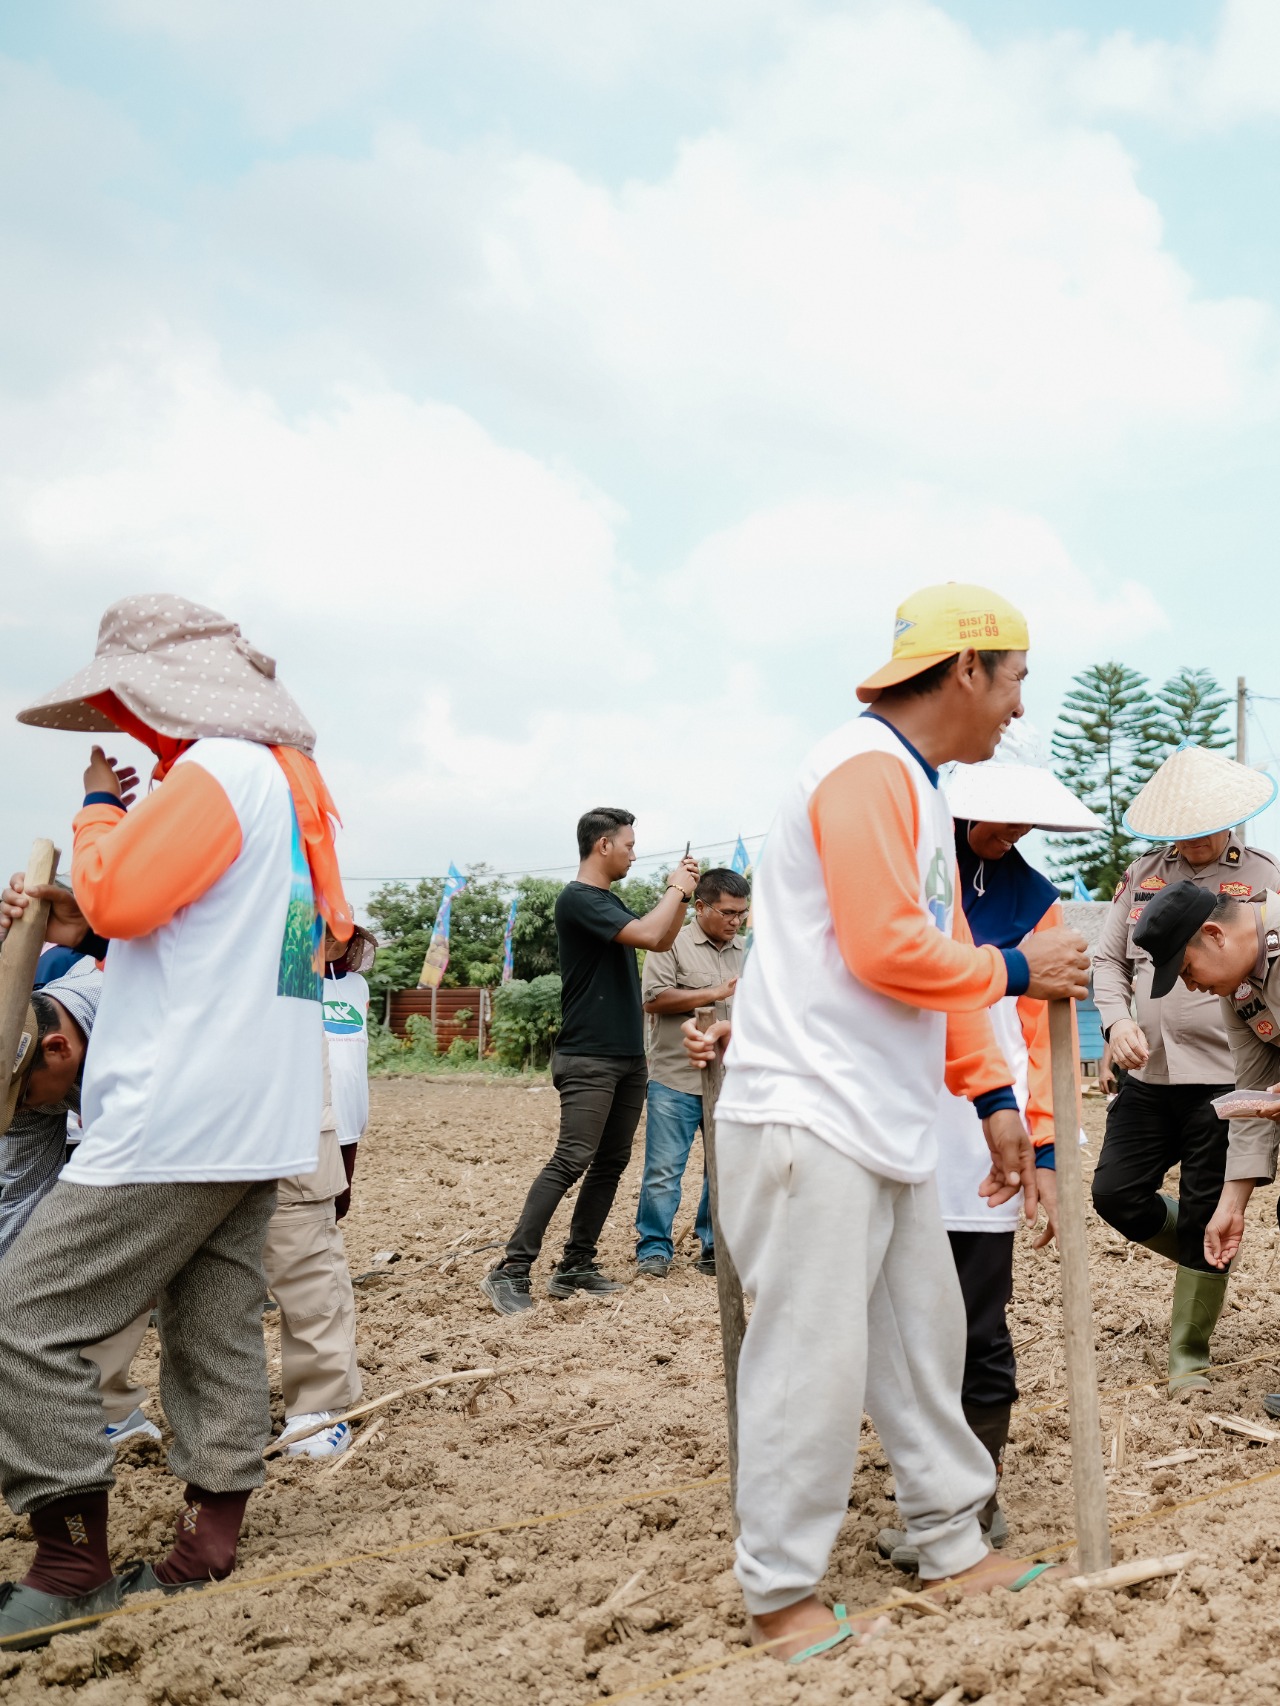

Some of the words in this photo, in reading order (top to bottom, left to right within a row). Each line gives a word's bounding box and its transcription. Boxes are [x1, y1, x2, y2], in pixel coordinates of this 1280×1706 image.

[958, 616, 981, 627] BISI
[983, 613, 996, 625] 79
[959, 629, 982, 640] BISI
[984, 625, 999, 637] 99
